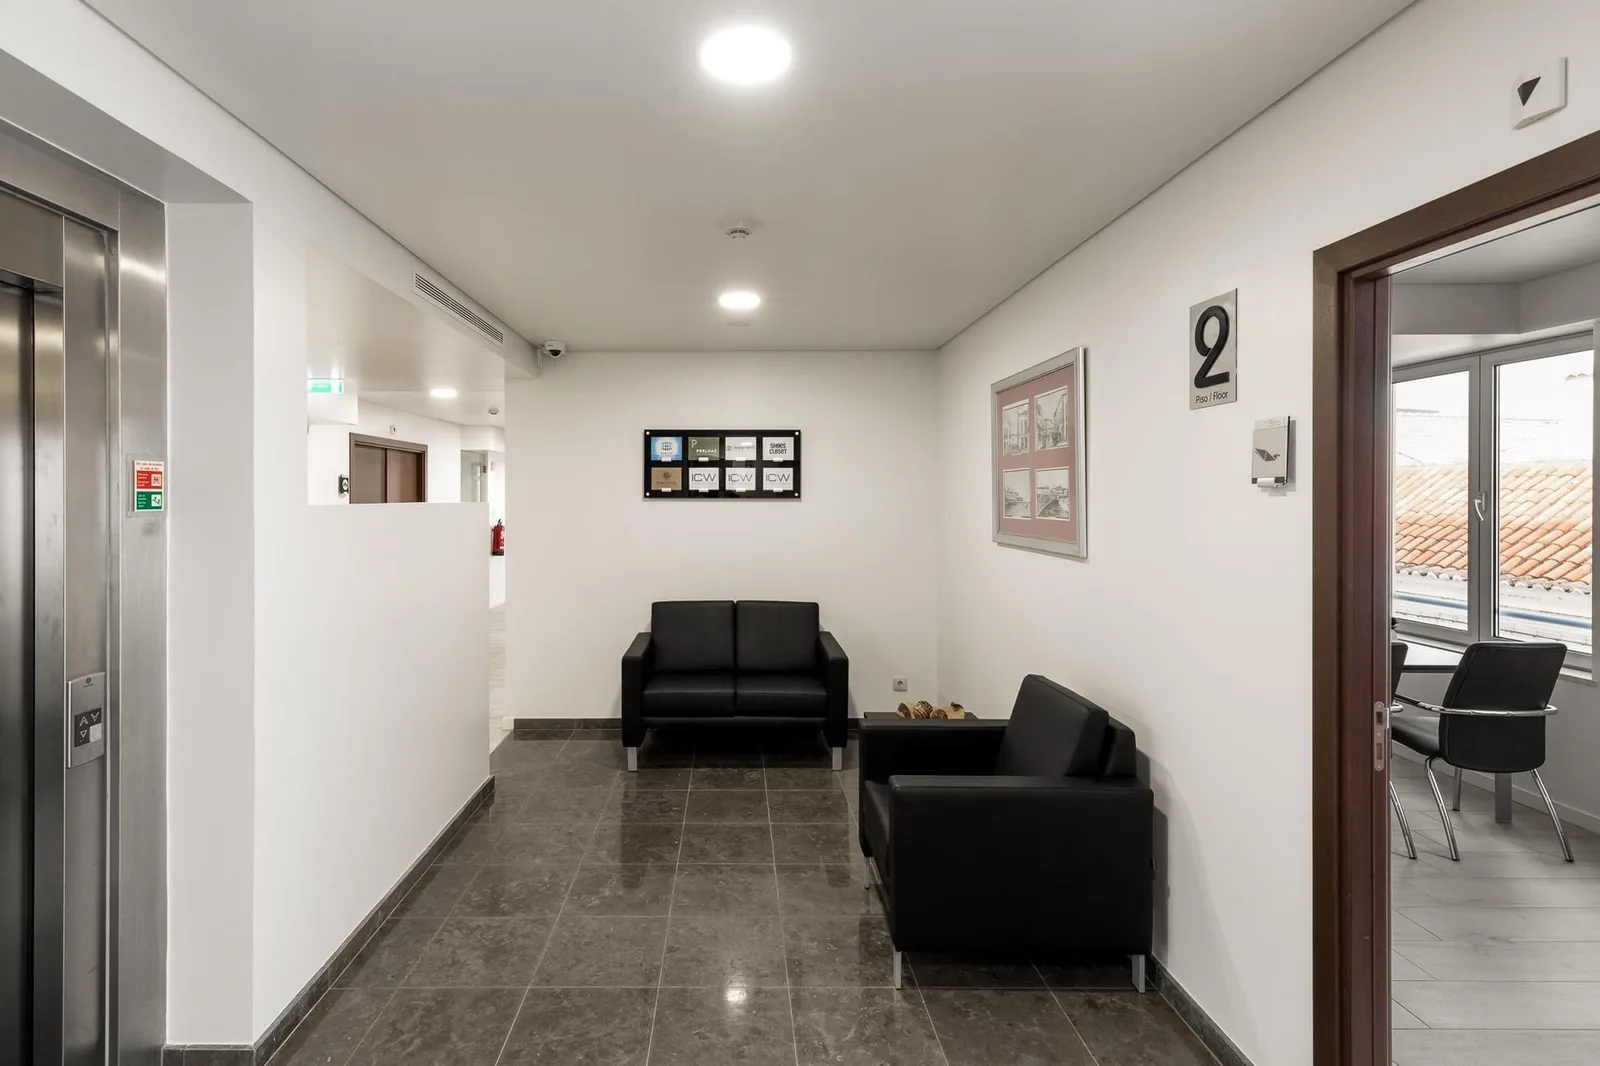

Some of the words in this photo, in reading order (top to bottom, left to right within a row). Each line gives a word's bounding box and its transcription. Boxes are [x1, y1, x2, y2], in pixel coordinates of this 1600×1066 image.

[1194, 305, 1230, 389] 2
[1195, 395, 1208, 404] Piso
[1213, 391, 1229, 401] Floor
[692, 473, 716, 482] ICW
[728, 473, 753, 482] ICW
[765, 473, 791, 482] ICW
